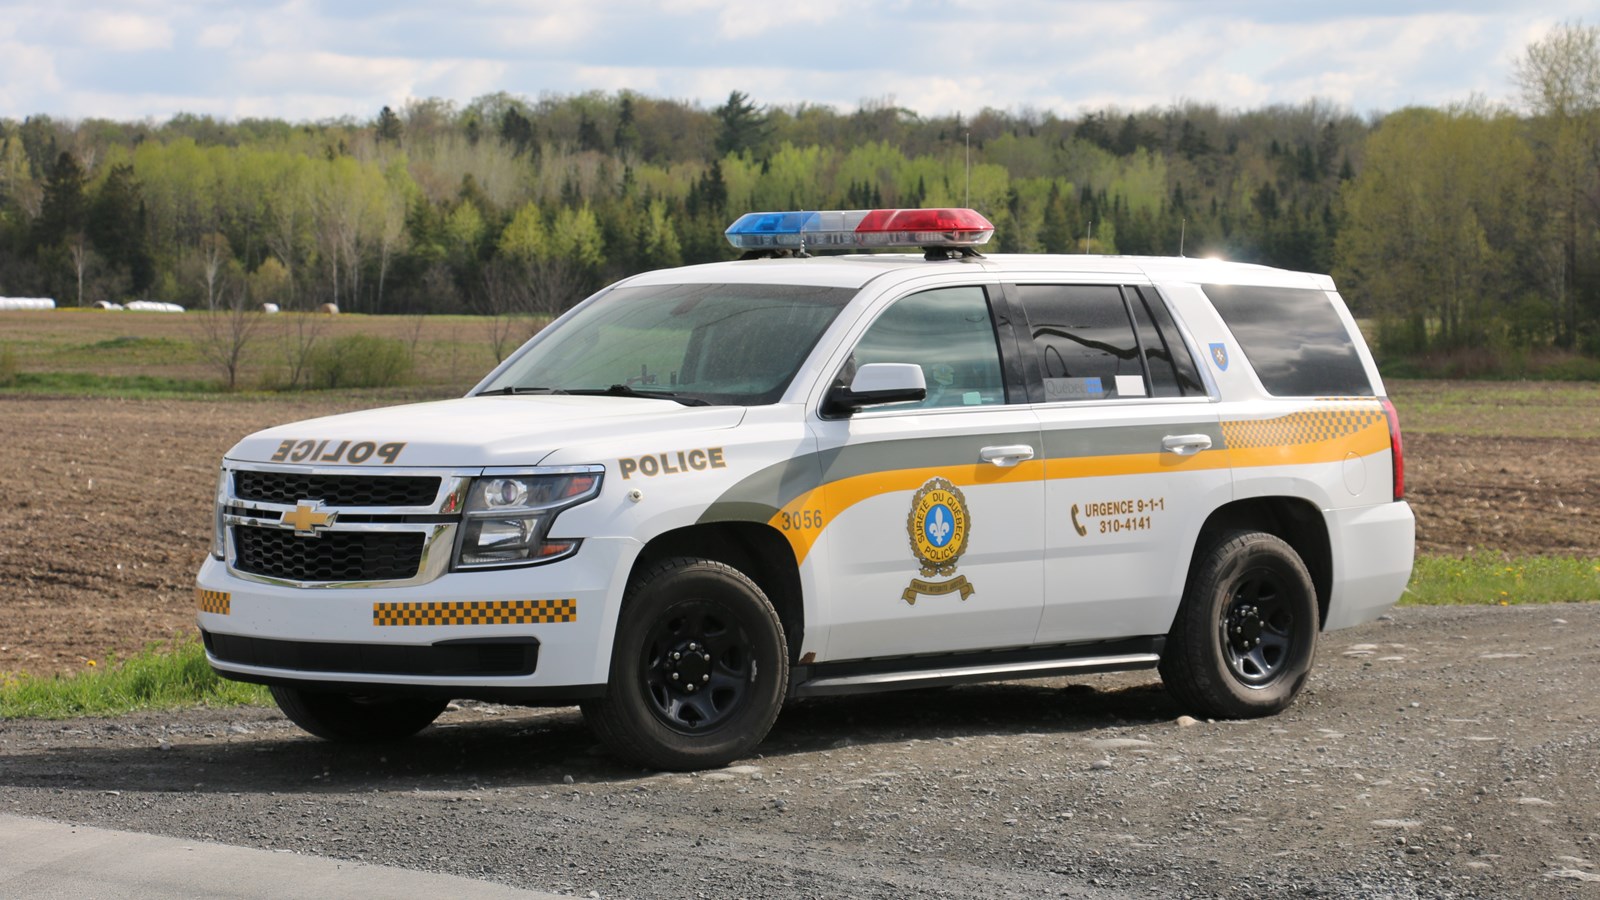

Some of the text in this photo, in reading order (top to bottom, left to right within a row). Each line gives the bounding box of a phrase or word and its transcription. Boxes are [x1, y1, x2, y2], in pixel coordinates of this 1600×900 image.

[618, 447, 727, 480] POLICE
[932, 493, 944, 501] DU
[1085, 497, 1164, 517] URGENCE 9-1-1
[781, 510, 822, 531] 3056
[1099, 516, 1151, 534] 310-4141
[924, 544, 955, 559] POLICE
